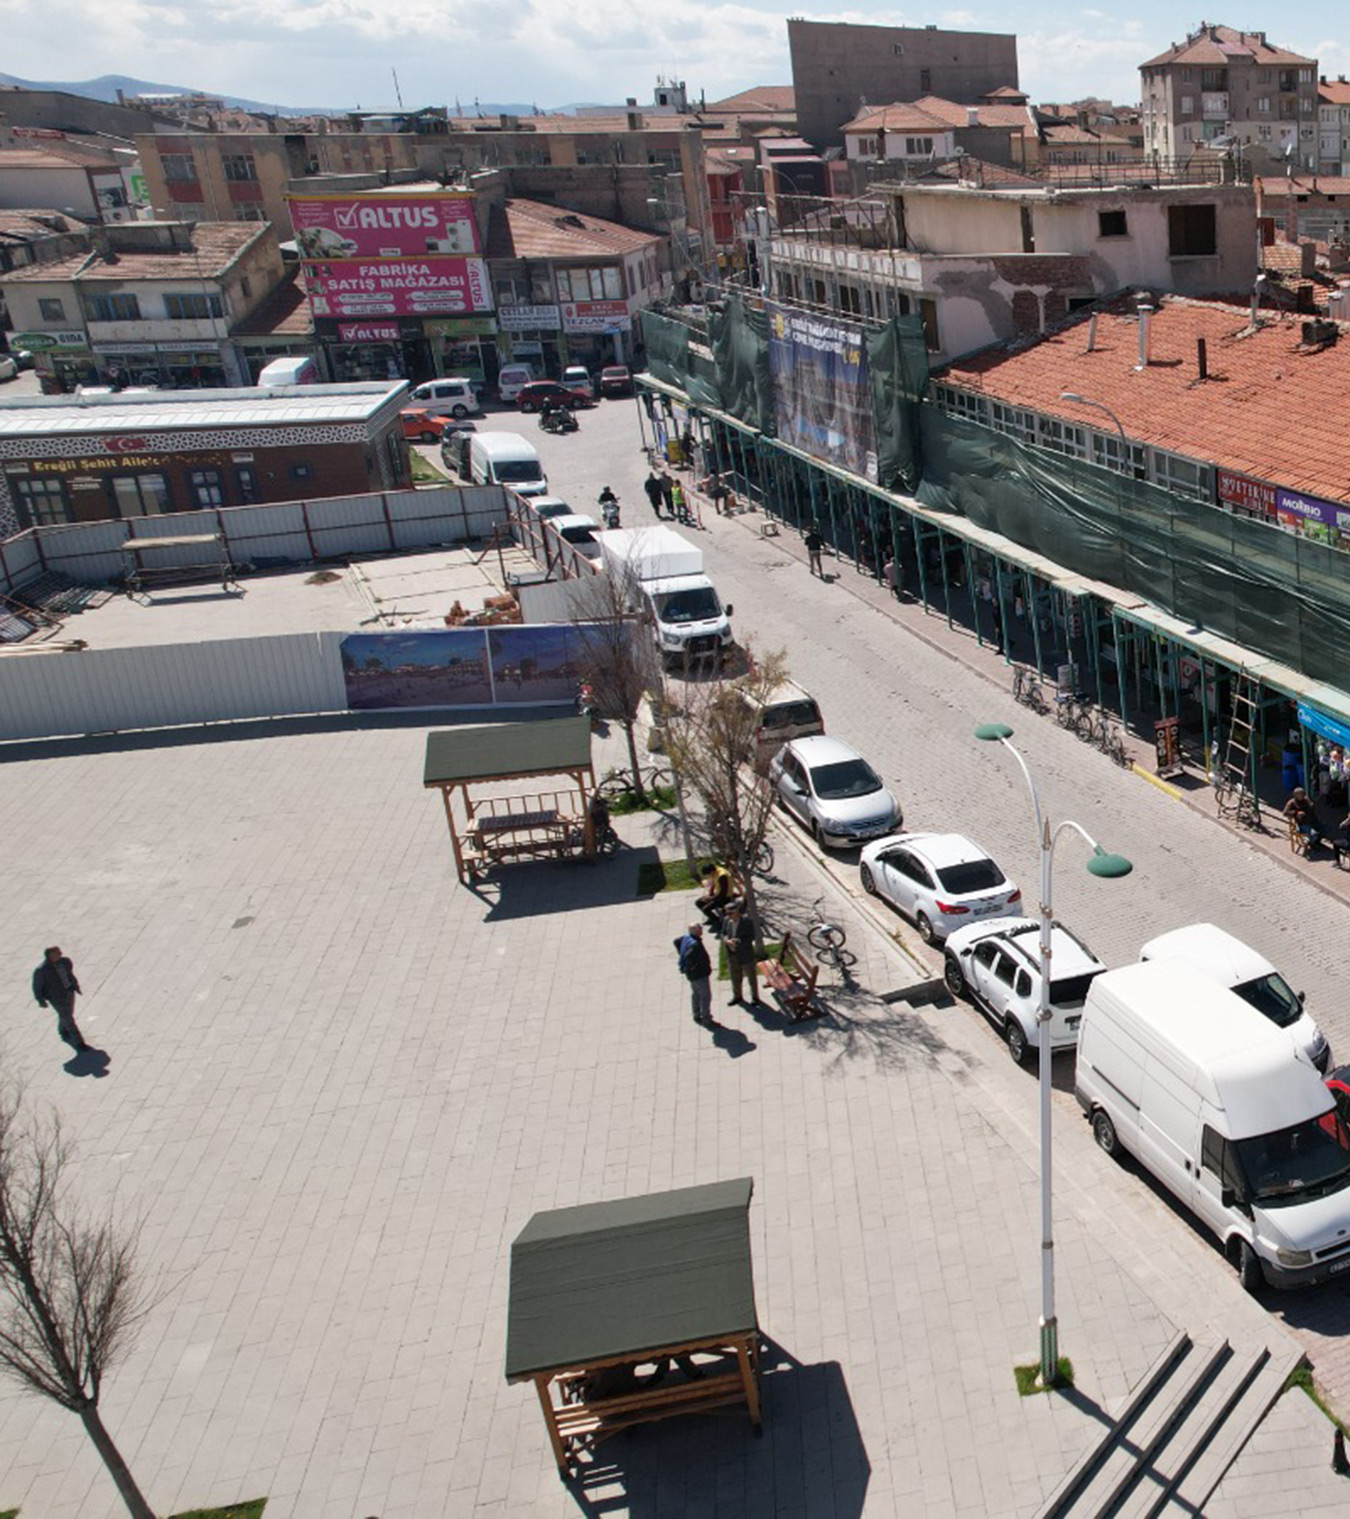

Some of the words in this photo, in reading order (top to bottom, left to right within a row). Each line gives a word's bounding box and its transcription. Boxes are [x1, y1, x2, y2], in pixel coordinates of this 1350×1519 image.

[360, 206, 439, 229] ALTUS
[359, 263, 431, 277] FABRİKA
[328, 279, 376, 291] SATIŞ
[380, 274, 465, 289] MAĞAZASI
[357, 327, 398, 340] ALTUS
[33, 460, 77, 472] Ereğli
[80, 457, 117, 472] Şehit
